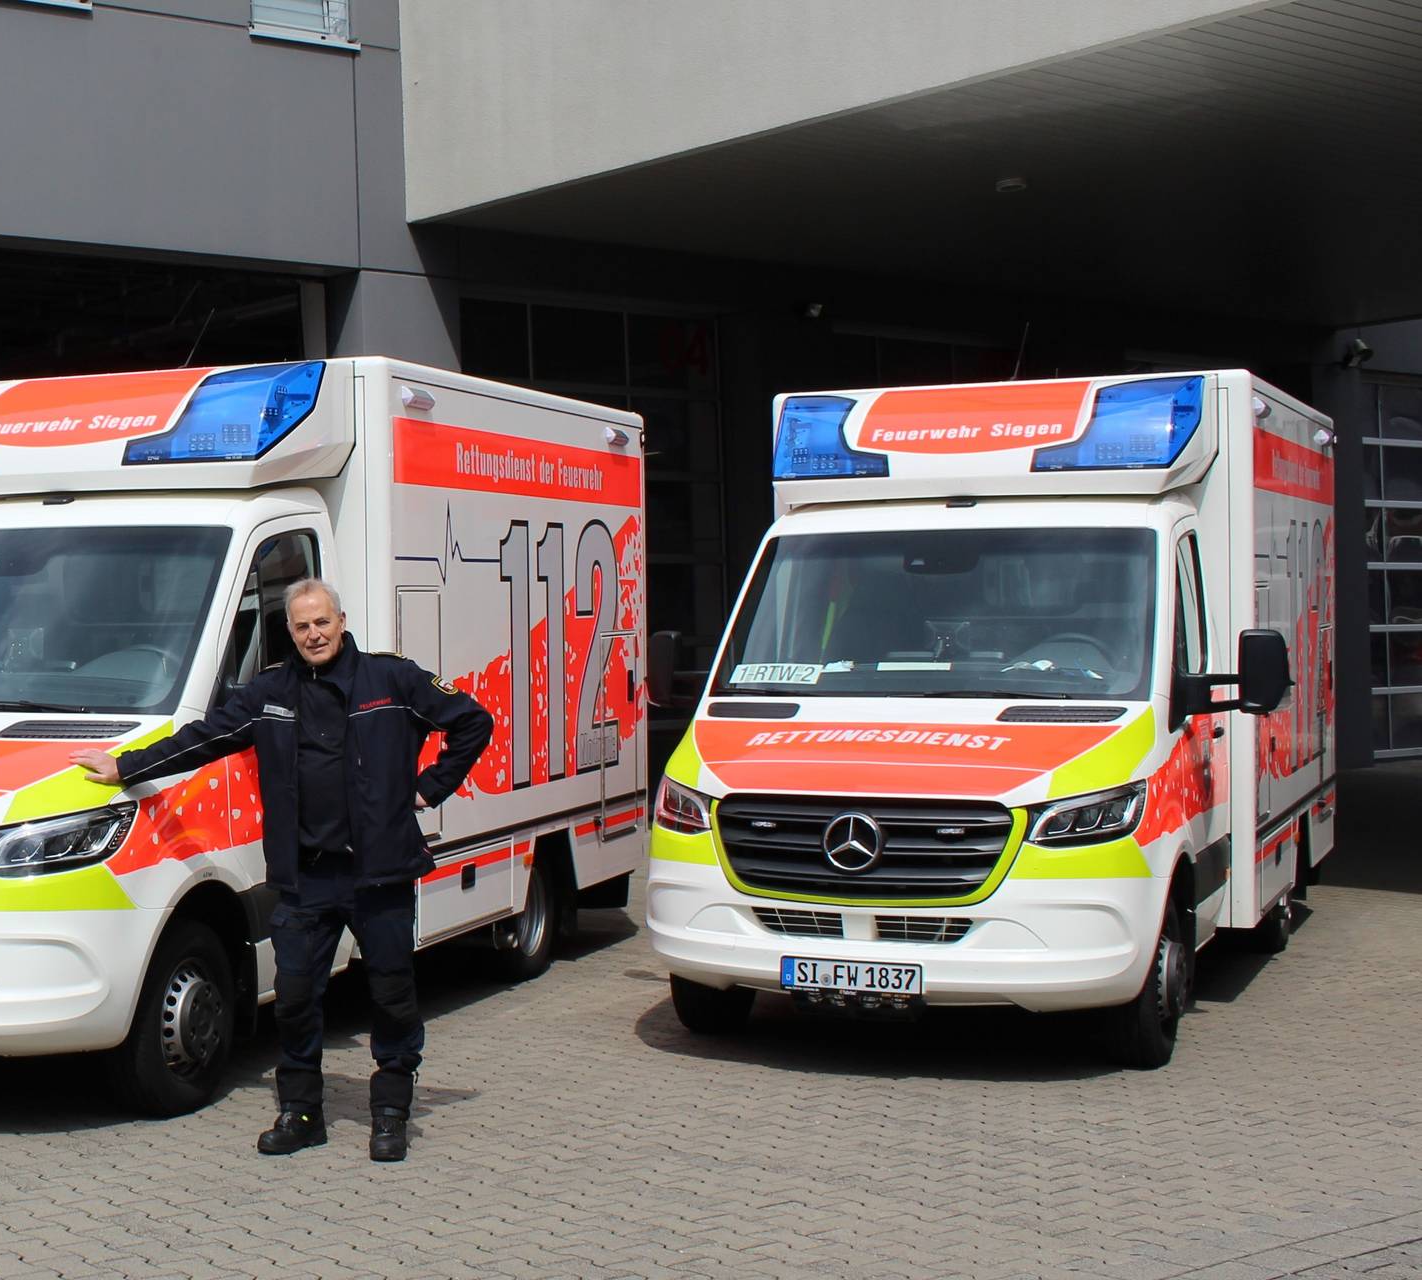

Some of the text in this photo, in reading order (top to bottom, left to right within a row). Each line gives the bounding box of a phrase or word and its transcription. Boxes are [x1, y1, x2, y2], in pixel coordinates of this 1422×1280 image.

[88, 414, 158, 431] Siegen
[871, 422, 1062, 442] Feuerwehr Siegen
[456, 442, 603, 491] Rettungsdienst der Feuerwehr
[499, 519, 619, 791] 112
[739, 664, 816, 683] 1-RTW-2
[746, 728, 1011, 751] RETTUNGSDIENST
[797, 962, 916, 990] SI FW 1837
